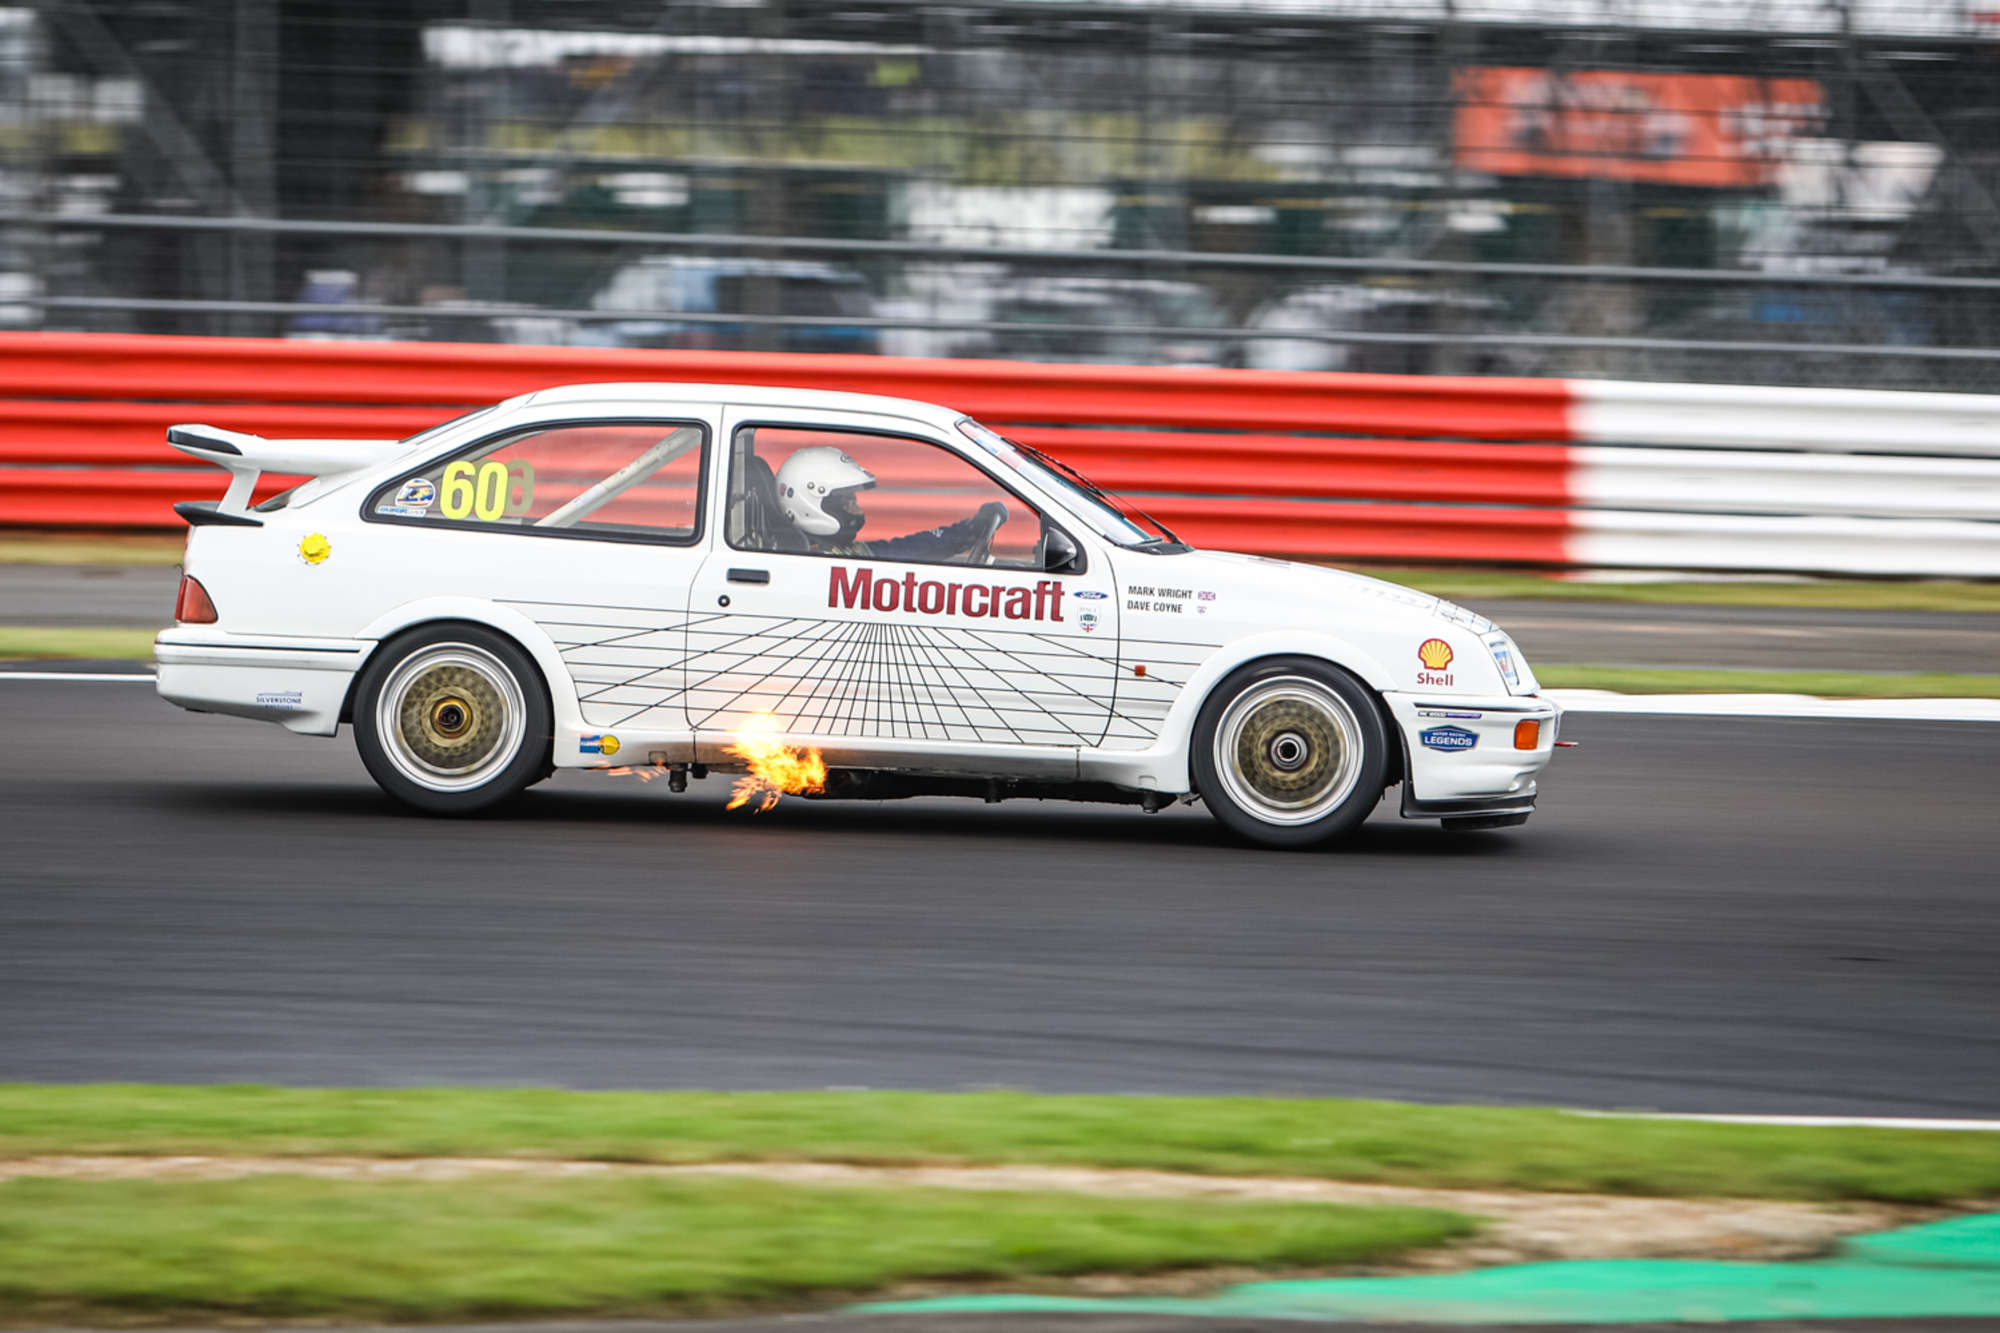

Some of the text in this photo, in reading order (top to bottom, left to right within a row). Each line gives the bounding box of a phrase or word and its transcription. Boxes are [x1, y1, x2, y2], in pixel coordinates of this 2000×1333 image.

[440, 460, 508, 522] 60
[828, 566, 1065, 622] Motorcraft
[1128, 585, 1193, 600] MARK WRIGHT
[1127, 600, 1183, 614] DAVE COYNE
[1416, 672, 1454, 686] Shell
[1425, 736, 1473, 746] LEGENDS
